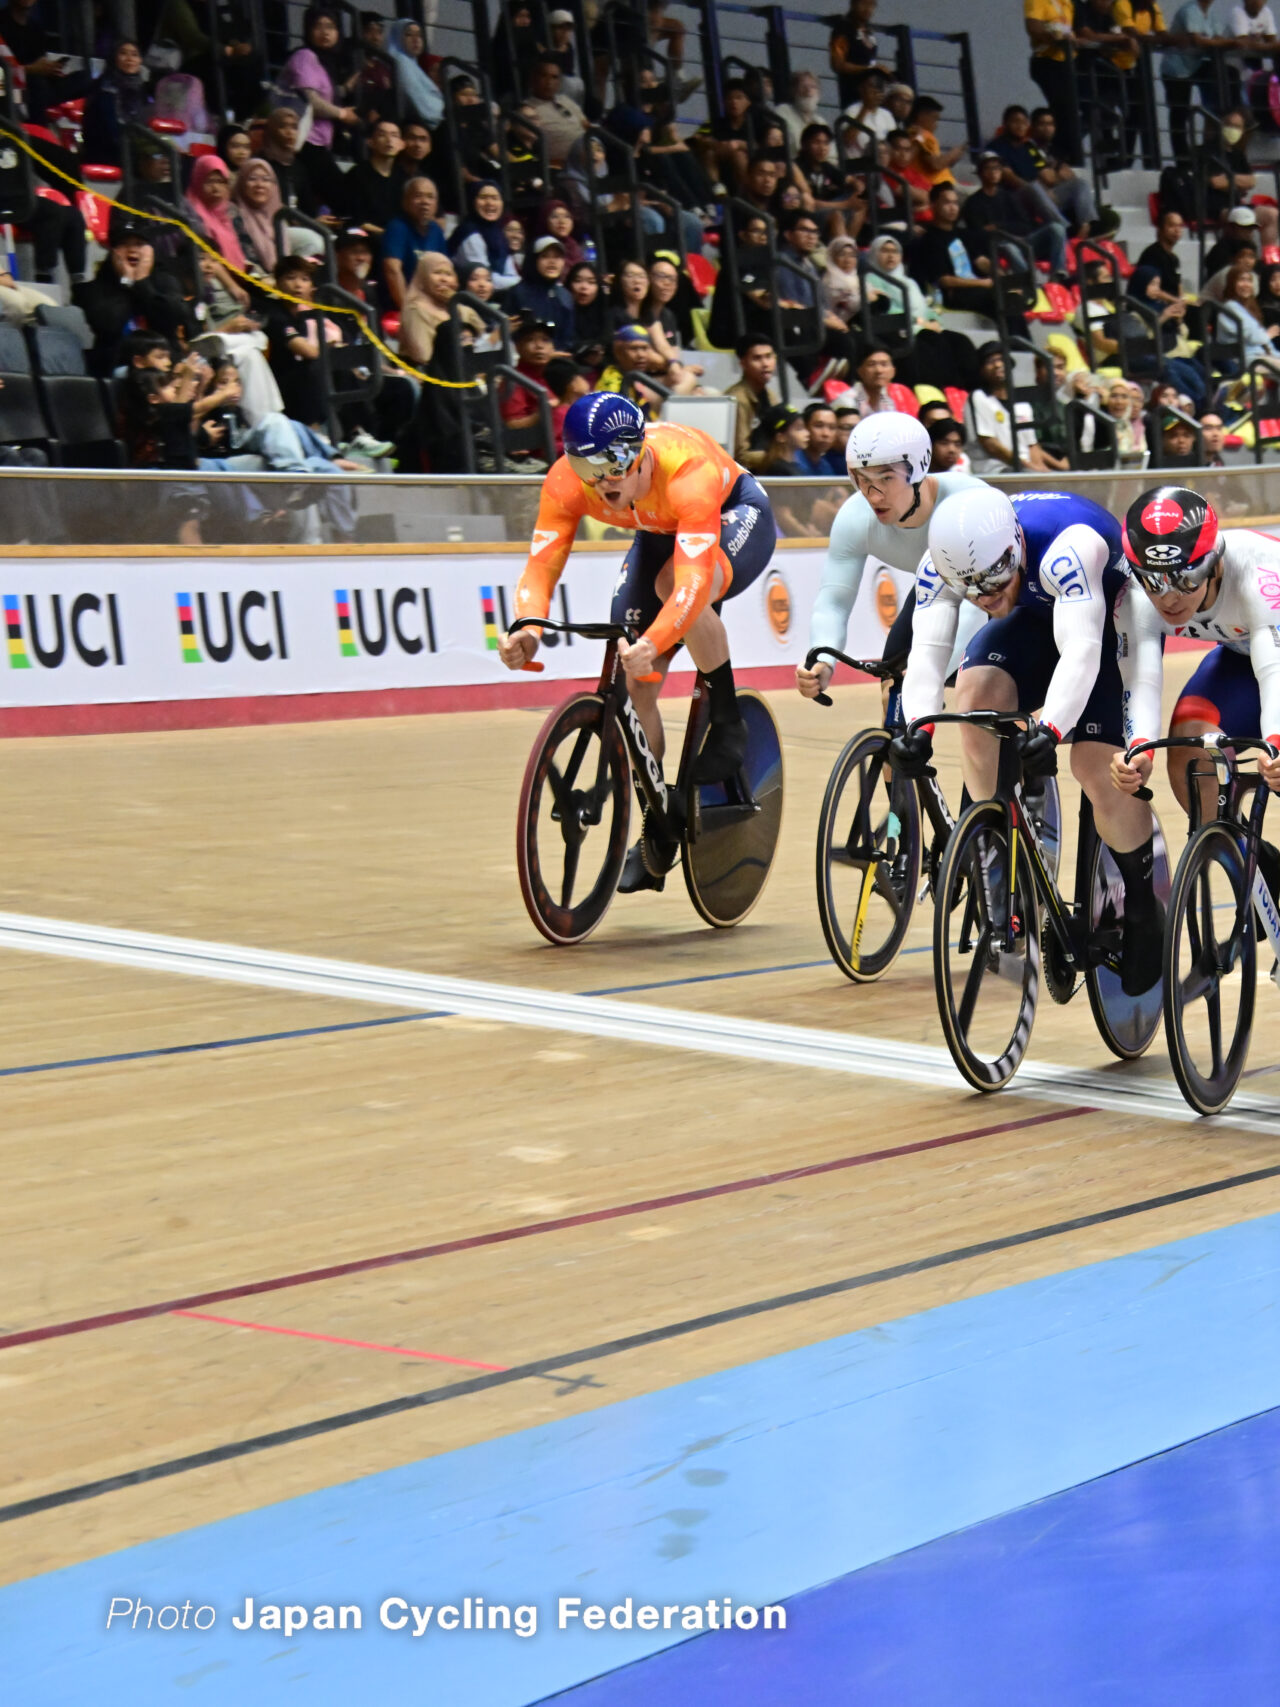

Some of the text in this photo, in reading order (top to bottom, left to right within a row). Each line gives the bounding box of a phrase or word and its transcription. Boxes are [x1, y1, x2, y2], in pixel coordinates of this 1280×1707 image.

[1145, 511, 1180, 520] JAPAN
[25, 592, 126, 669] UCI
[197, 590, 289, 663] UCI
[353, 586, 439, 657] UCI
[623, 695, 669, 815] KOGA
